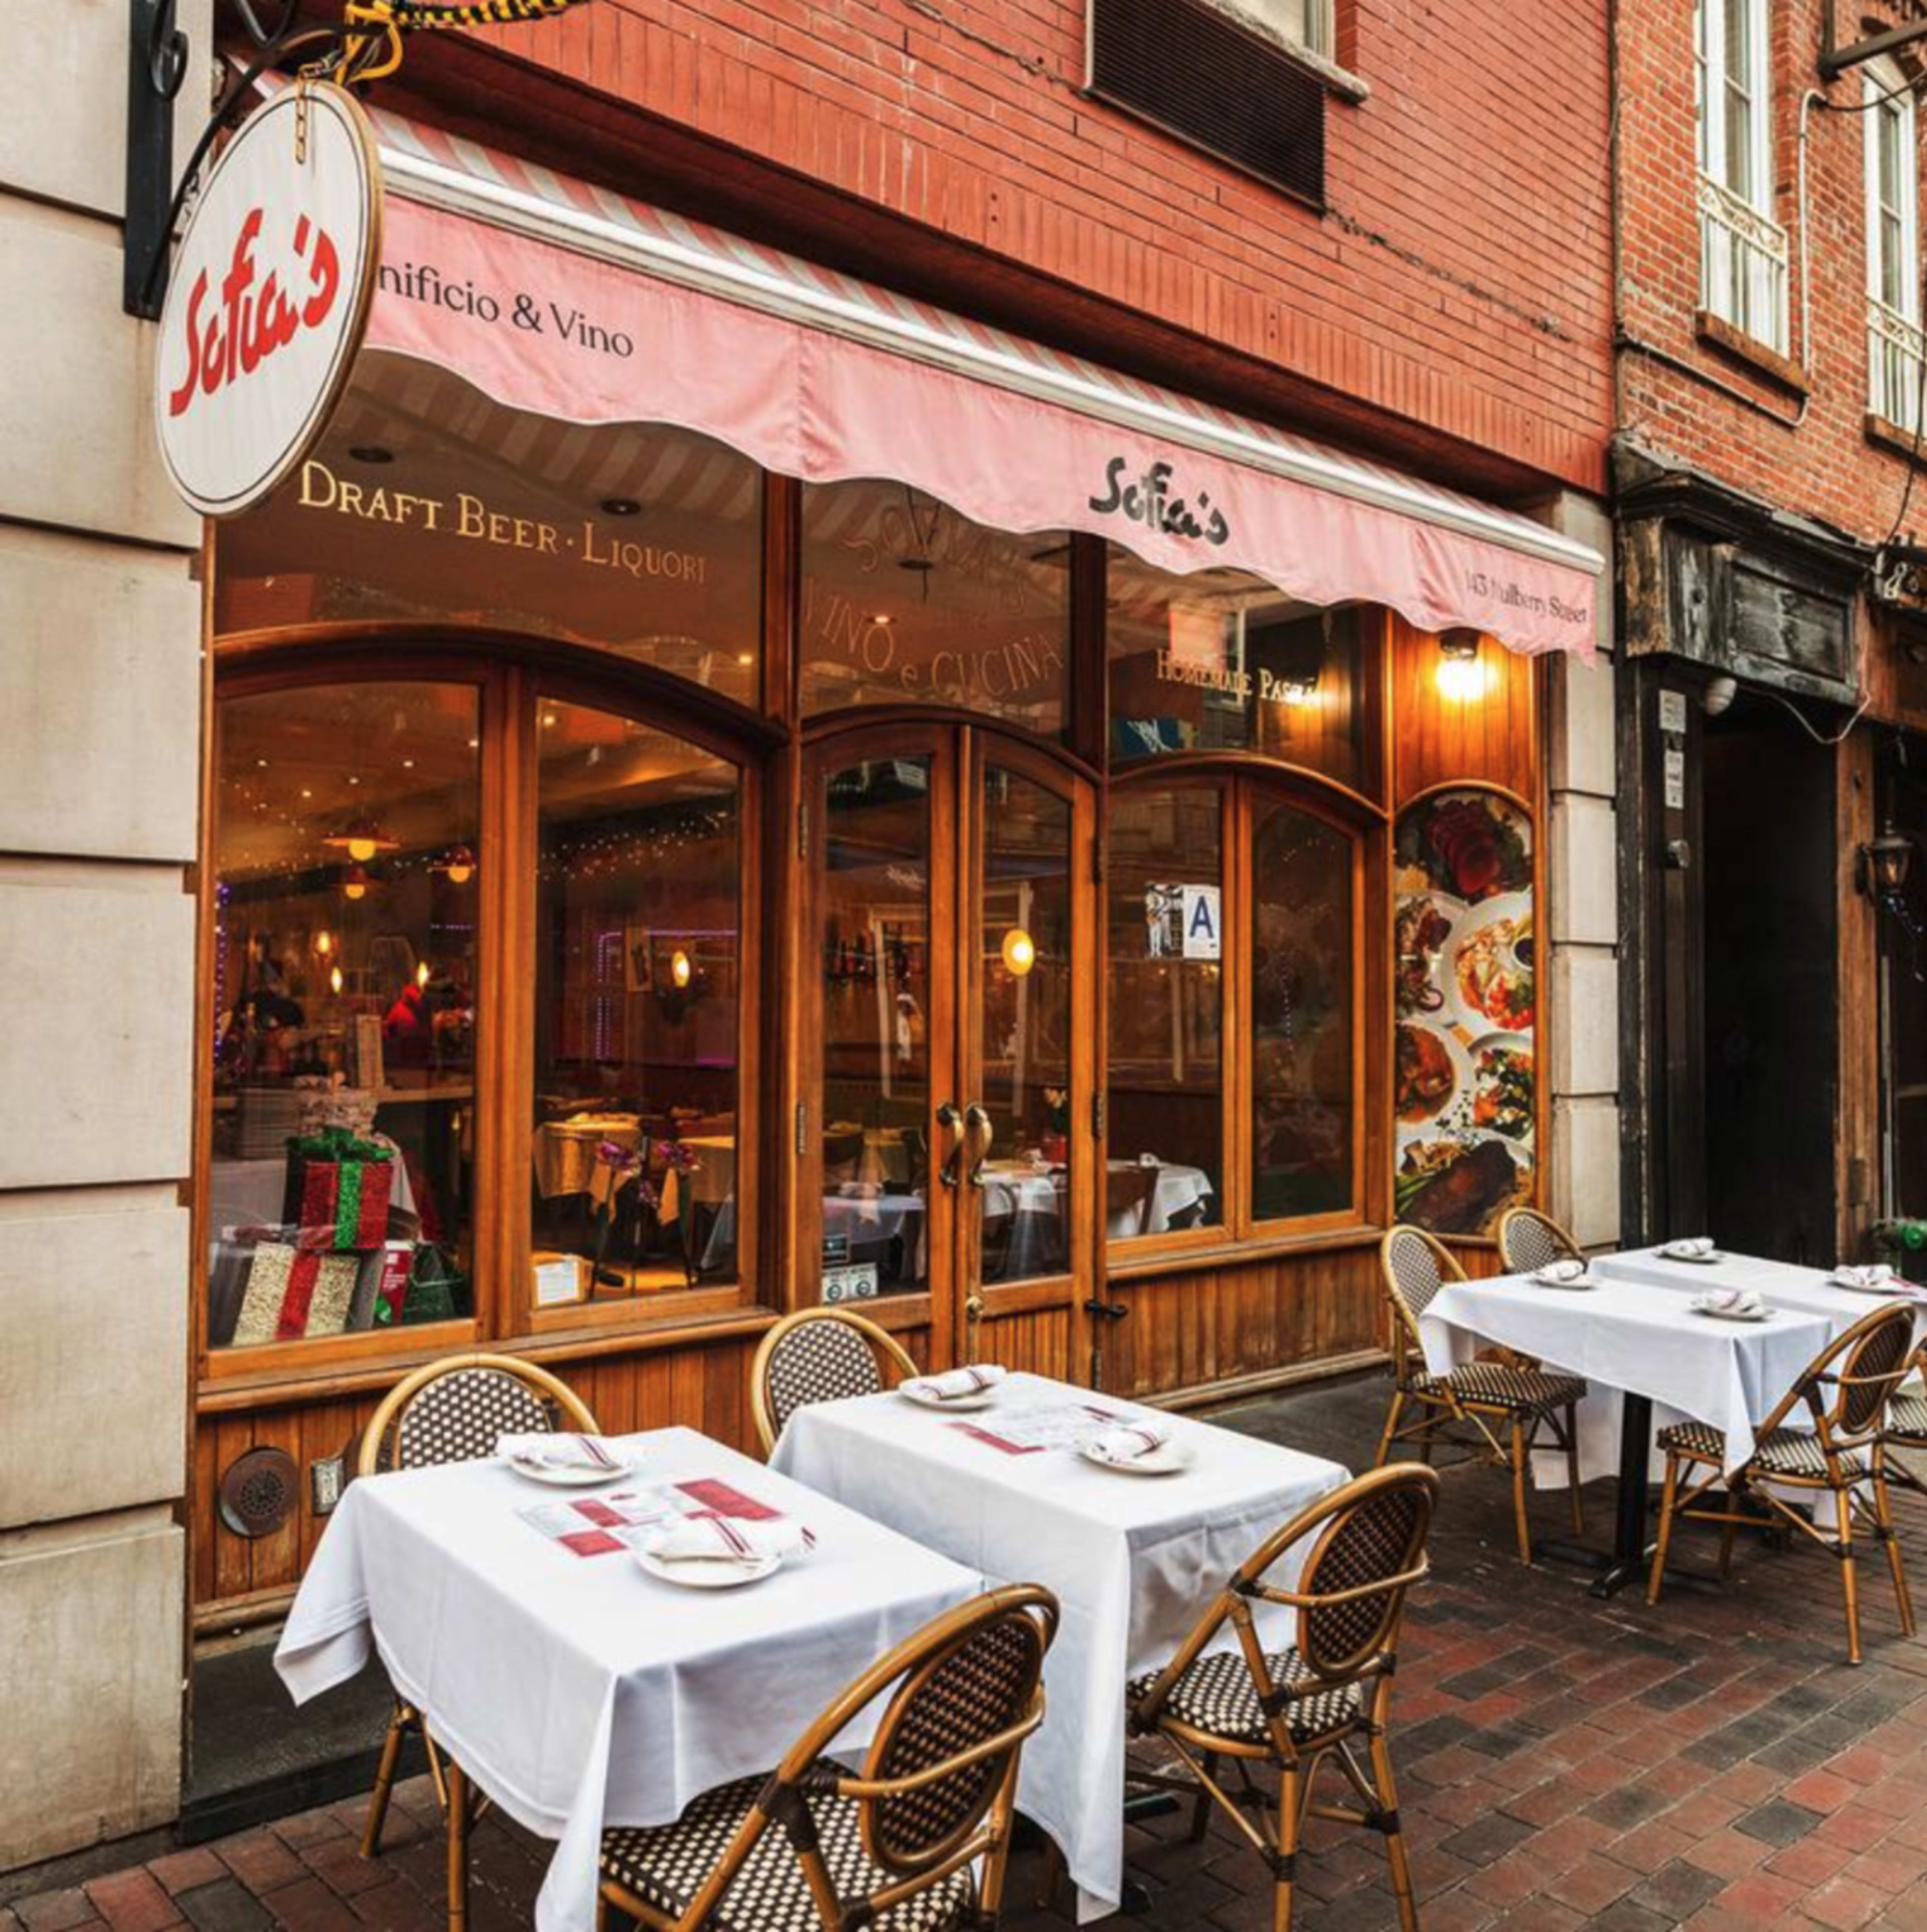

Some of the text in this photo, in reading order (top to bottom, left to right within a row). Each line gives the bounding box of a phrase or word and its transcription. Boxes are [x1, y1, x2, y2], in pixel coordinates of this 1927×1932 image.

[170, 208, 339, 417] Sofia's
[511, 294, 543, 333] &
[549, 303, 634, 358] Vino
[299, 459, 443, 530] DRAFT
[456, 493, 558, 555] BEER
[1088, 457, 1229, 545] Sofia's
[1189, 894, 1214, 938] A
